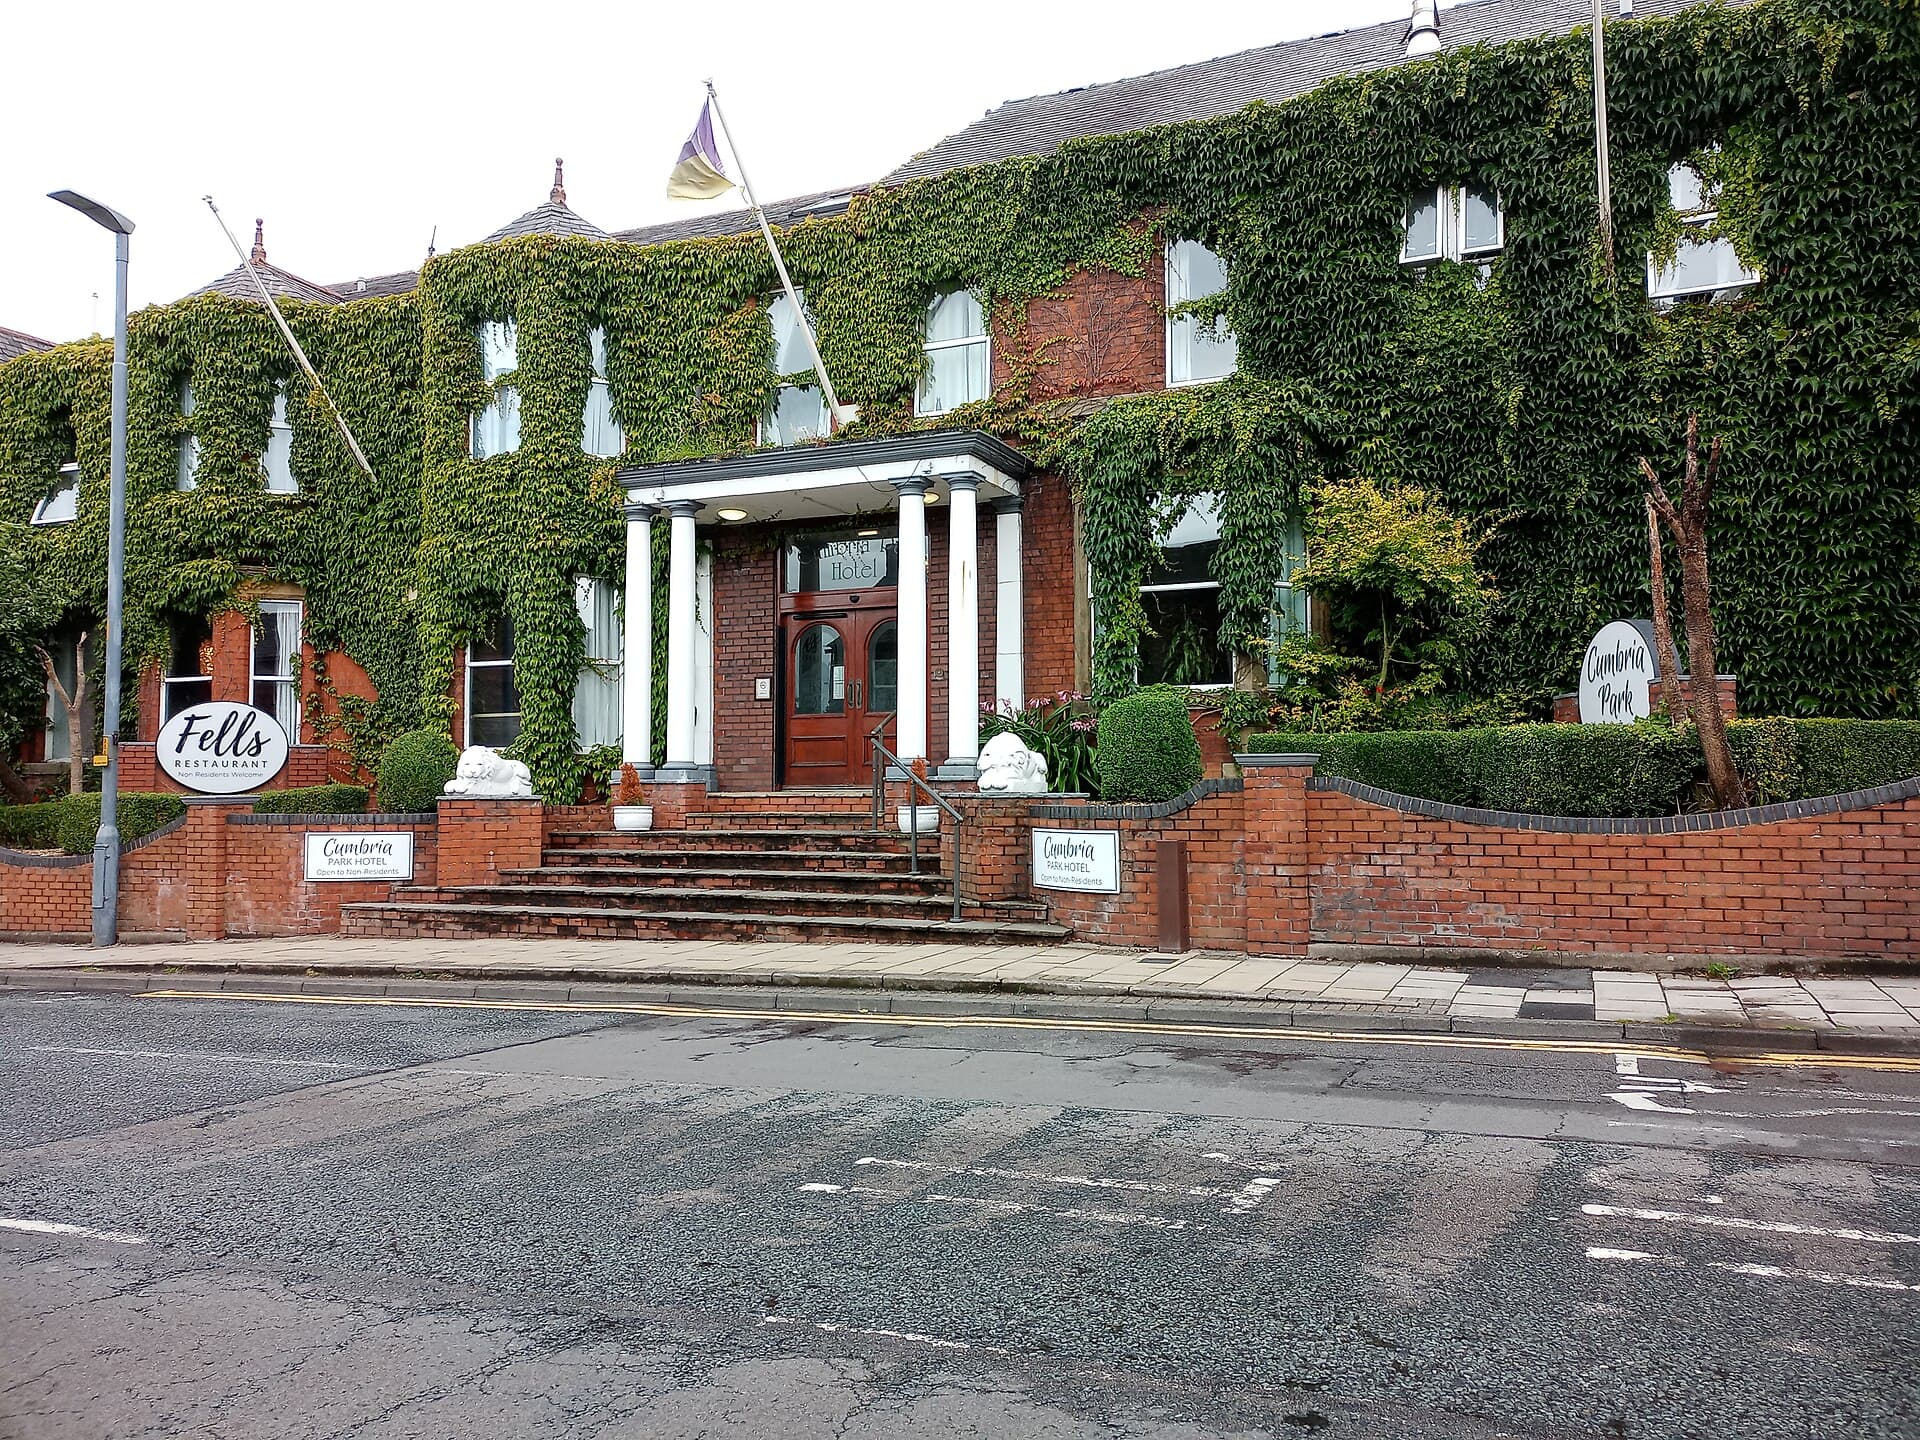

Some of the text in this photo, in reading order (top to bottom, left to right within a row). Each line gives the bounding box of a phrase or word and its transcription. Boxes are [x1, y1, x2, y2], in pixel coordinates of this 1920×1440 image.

[831, 557, 877, 581] Hotel
[1587, 639, 1645, 683] Cumbria
[1597, 680, 1634, 719] Park
[175, 710, 272, 757] Fells
[174, 759, 269, 768] RESTAURANT
[323, 837, 393, 857] Cumbria
[1044, 836, 1095, 862] Cumbria
[327, 857, 388, 866] PARK HOTEL
[1047, 861, 1090, 872] PARK HOTEL
